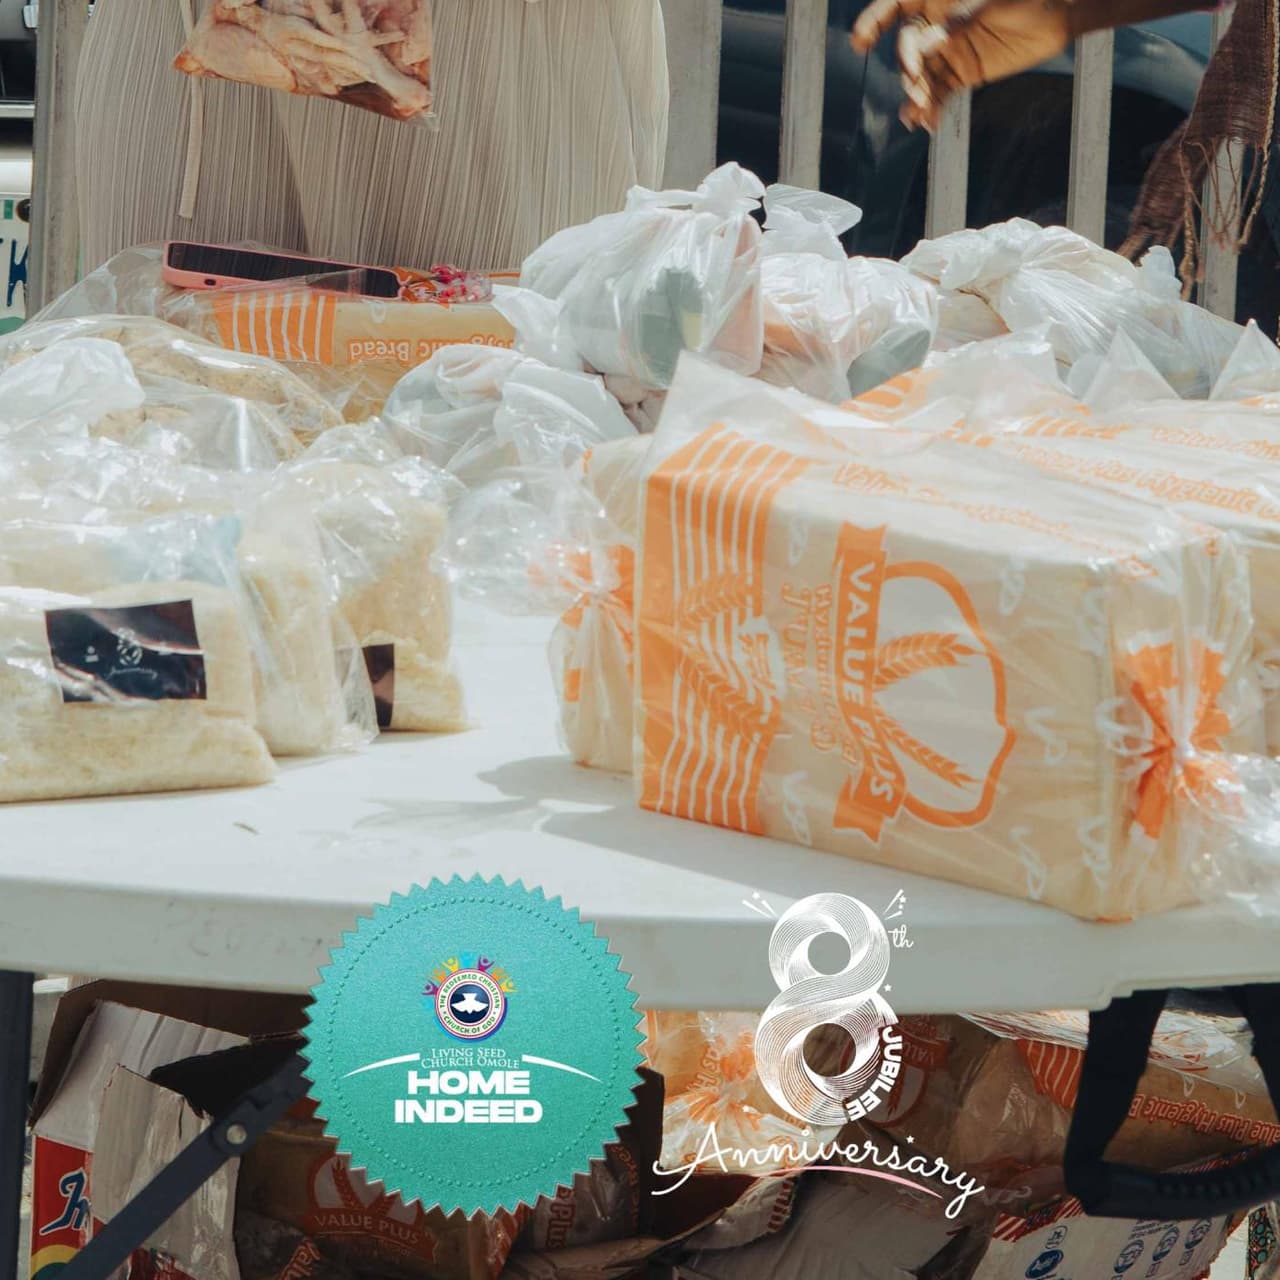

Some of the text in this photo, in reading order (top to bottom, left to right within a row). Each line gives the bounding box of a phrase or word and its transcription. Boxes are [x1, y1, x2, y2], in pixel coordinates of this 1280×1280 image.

[842, 561, 876, 708] VALUE
[313, 1213, 422, 1245] VALUE PLUS
